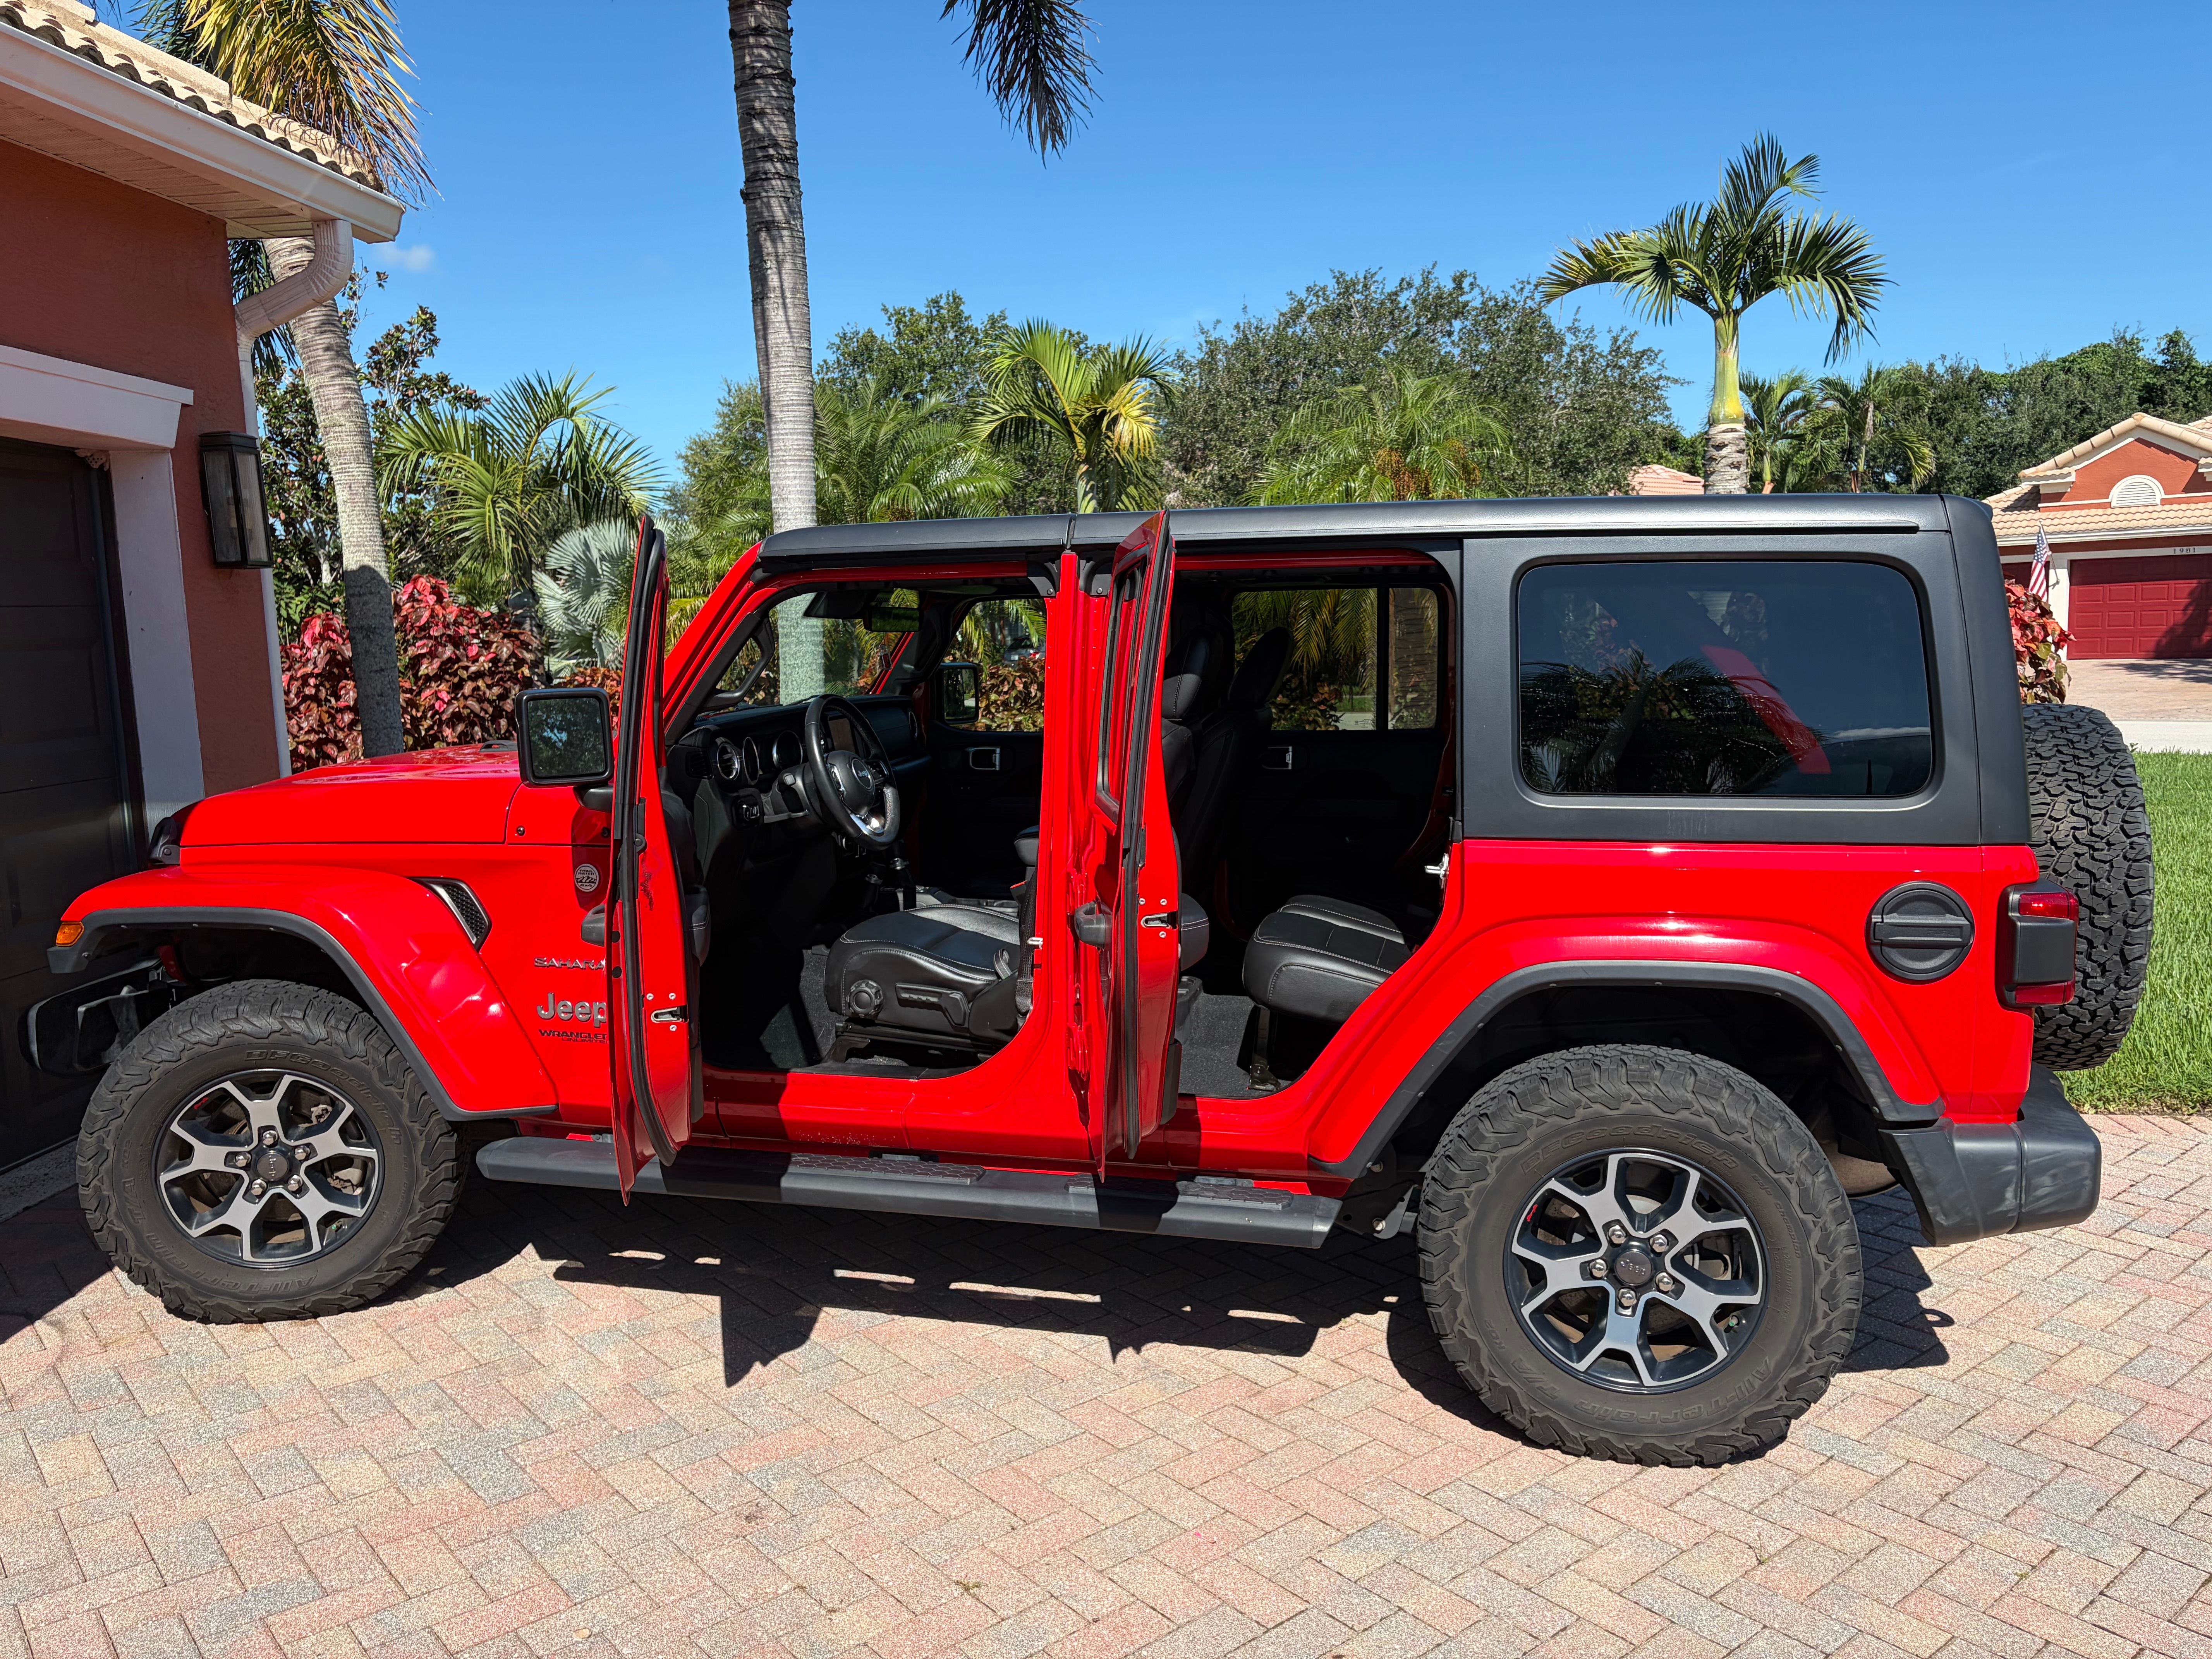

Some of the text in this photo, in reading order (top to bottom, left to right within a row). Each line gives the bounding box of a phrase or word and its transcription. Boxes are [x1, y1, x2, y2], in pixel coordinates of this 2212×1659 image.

[534, 957, 606, 970] SAHARA
[537, 992, 606, 1028] Jeep
[245, 1049, 402, 1145] BFGoodrich
[1520, 1124, 1739, 1176] BFGoodrich
[1774, 1201, 1800, 1259] Champion
[1620, 1259, 1646, 1276] Jeep
[1511, 1357, 1561, 1400] T/A
[1573, 1355, 1772, 1424] All-Terrain
